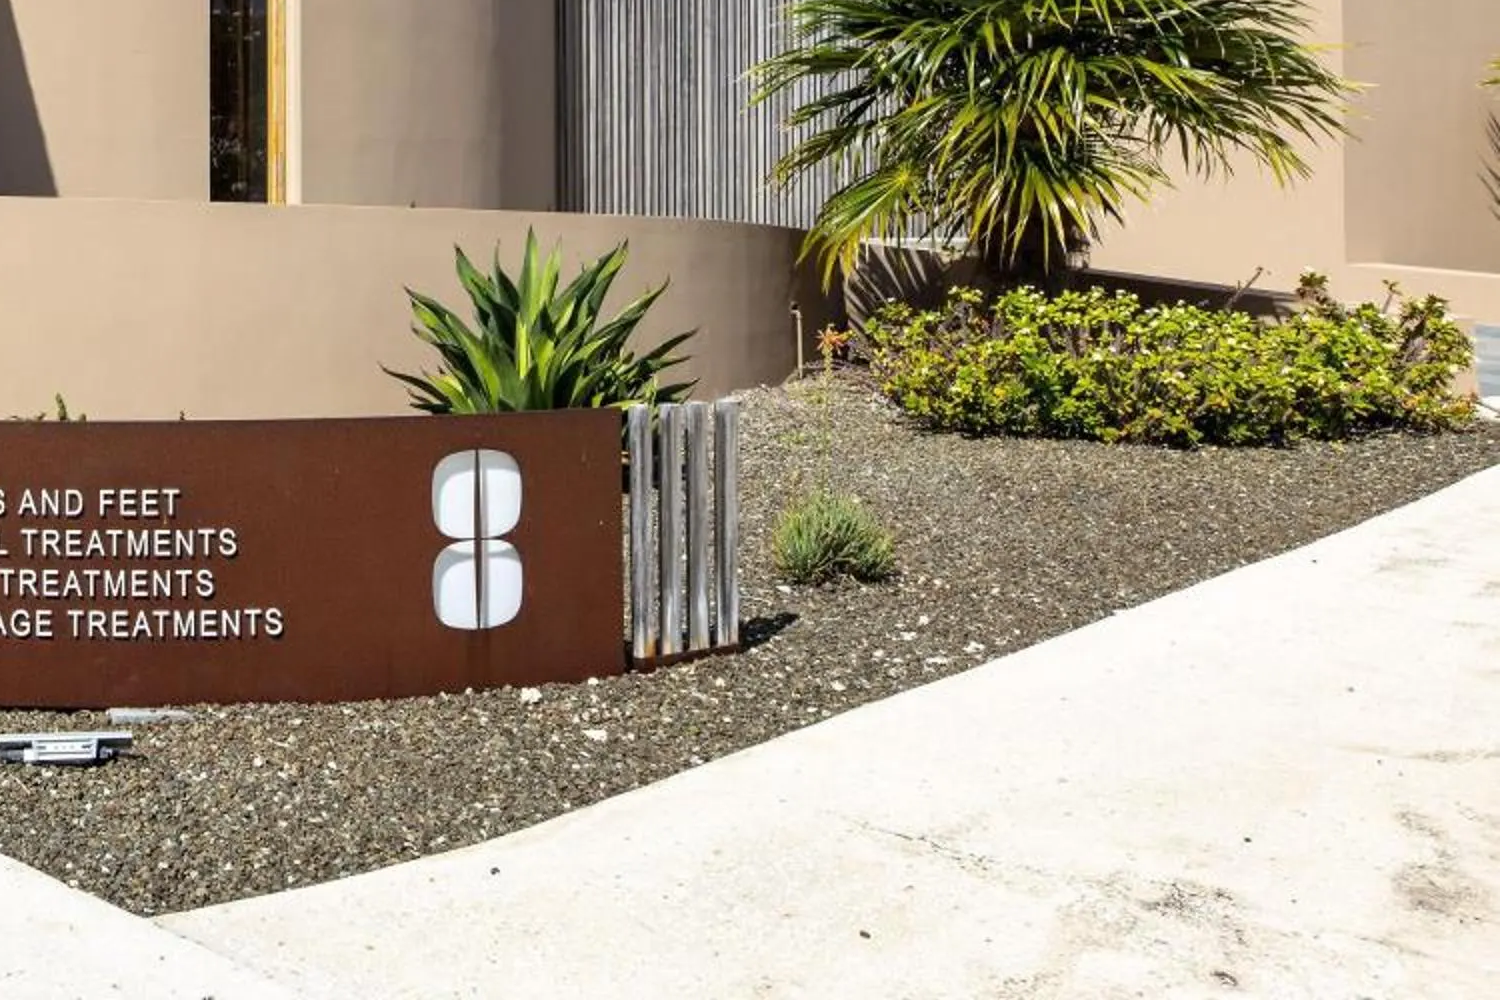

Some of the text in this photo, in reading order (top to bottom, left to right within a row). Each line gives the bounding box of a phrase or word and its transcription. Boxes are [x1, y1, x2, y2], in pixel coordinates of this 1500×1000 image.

[17, 488, 84, 517] AND
[99, 488, 181, 517] FEET
[19, 527, 237, 557] TREATMENTS
[66, 607, 283, 638] TREATMENTS
